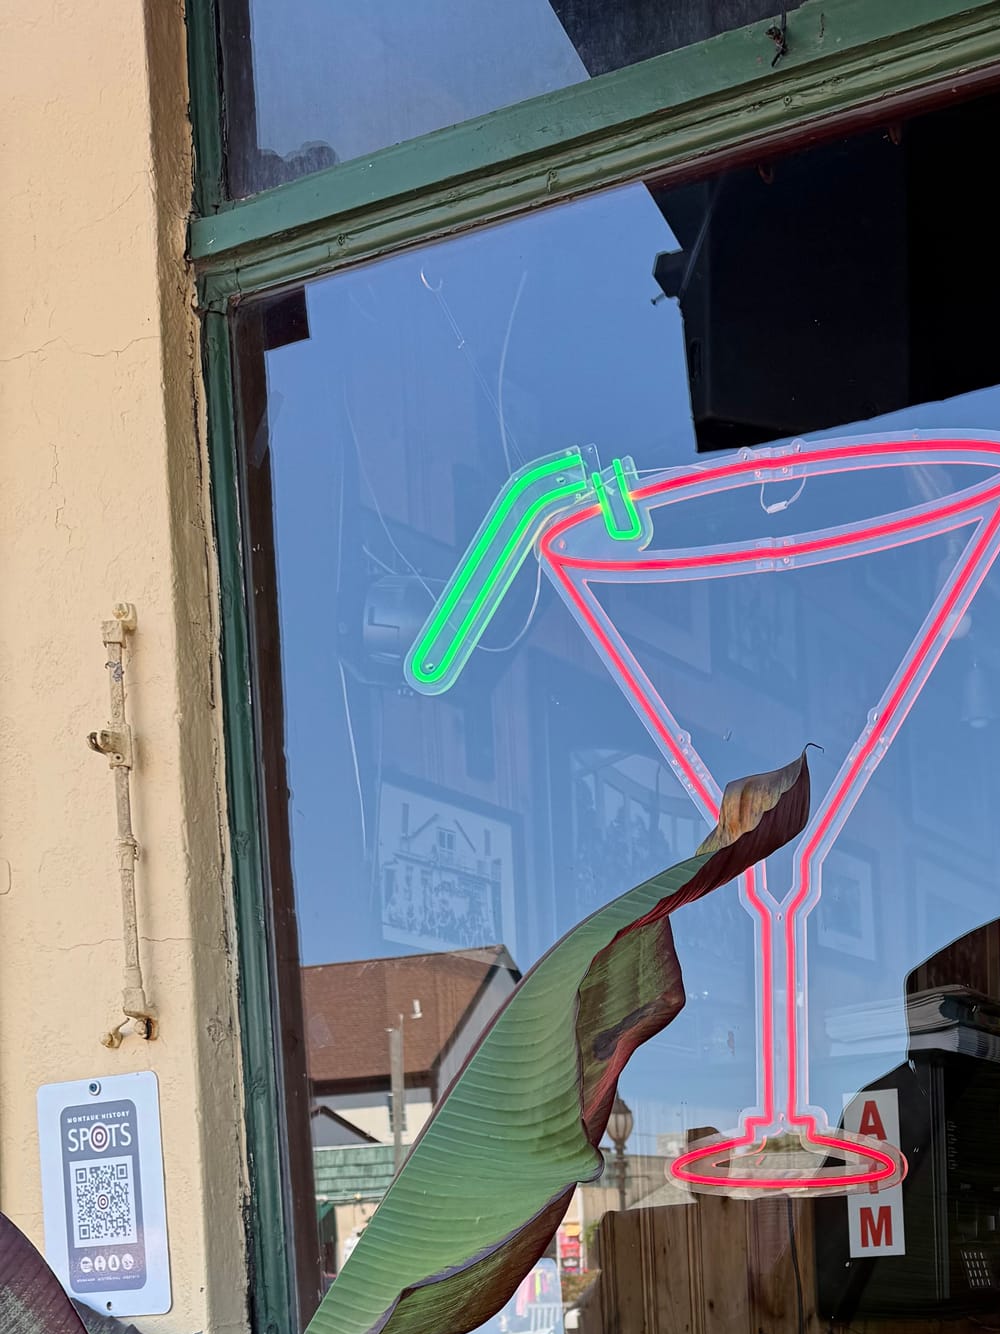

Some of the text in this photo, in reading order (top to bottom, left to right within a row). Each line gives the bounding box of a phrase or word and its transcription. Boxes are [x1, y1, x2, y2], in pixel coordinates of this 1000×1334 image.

[67, 1110, 130, 1124] MONTAUK HISTORY
[67, 1122, 132, 1153] SPOTS
